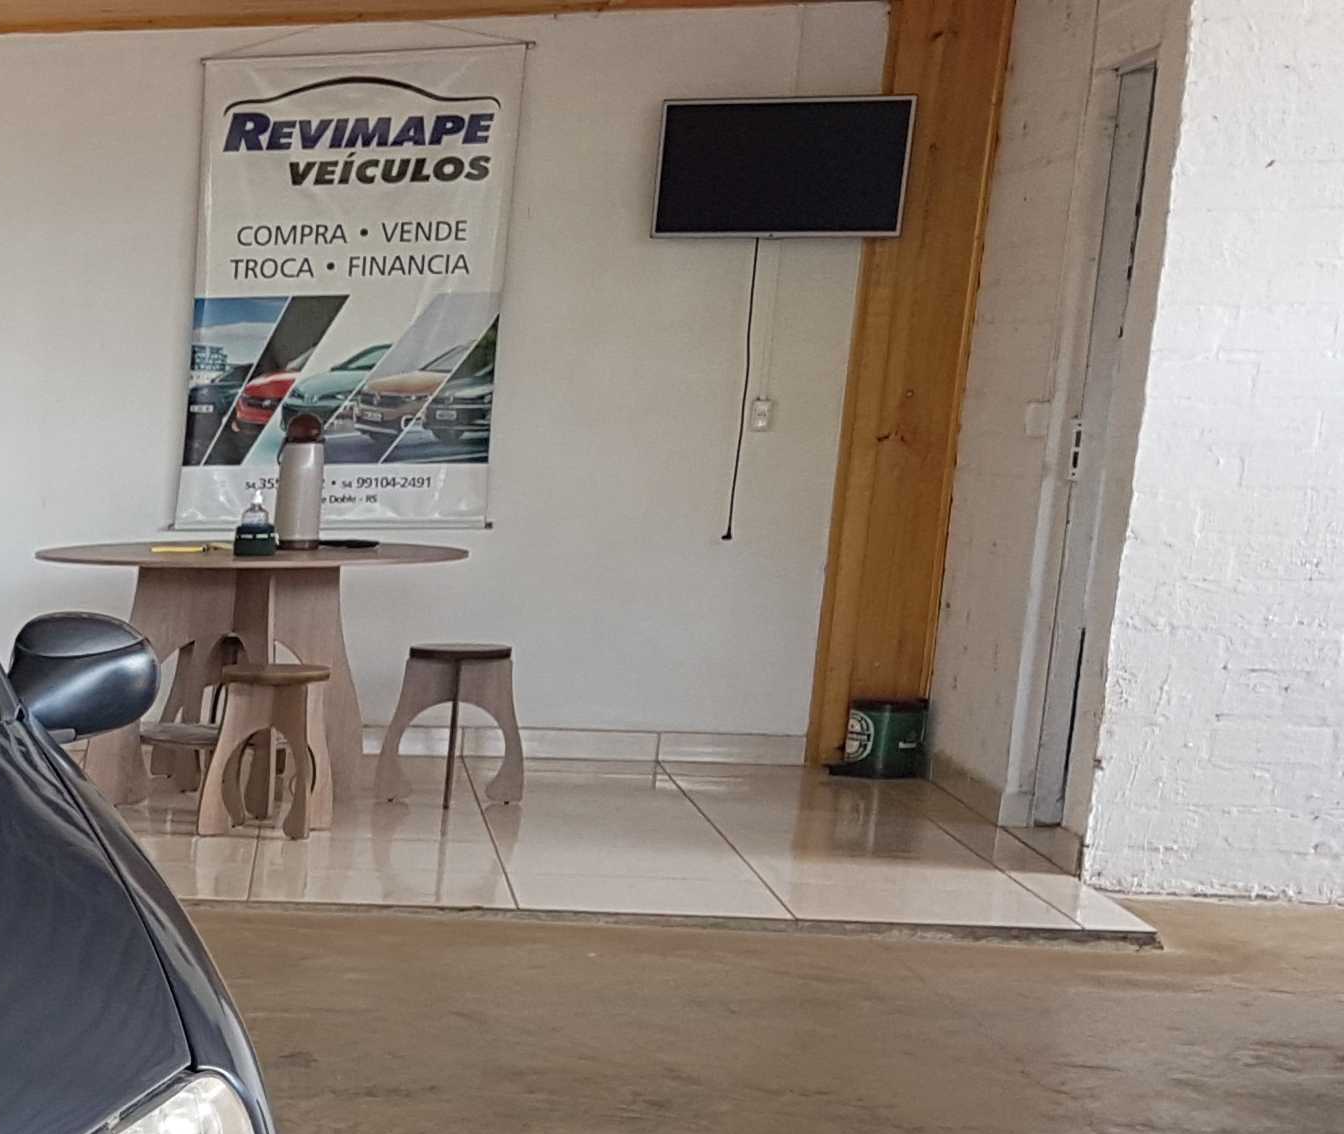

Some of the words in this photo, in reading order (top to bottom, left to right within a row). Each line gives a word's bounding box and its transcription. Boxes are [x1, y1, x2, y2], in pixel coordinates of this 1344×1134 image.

[223, 111, 495, 153] REVIMAPE
[289, 153, 492, 186] VEÍCULOS
[237, 224, 348, 246] COMPRA
[382, 220, 468, 243] VENDE
[231, 258, 315, 279] TROCA
[347, 254, 469, 277] FINANCIA
[356, 476, 432, 489] 99104-2491
